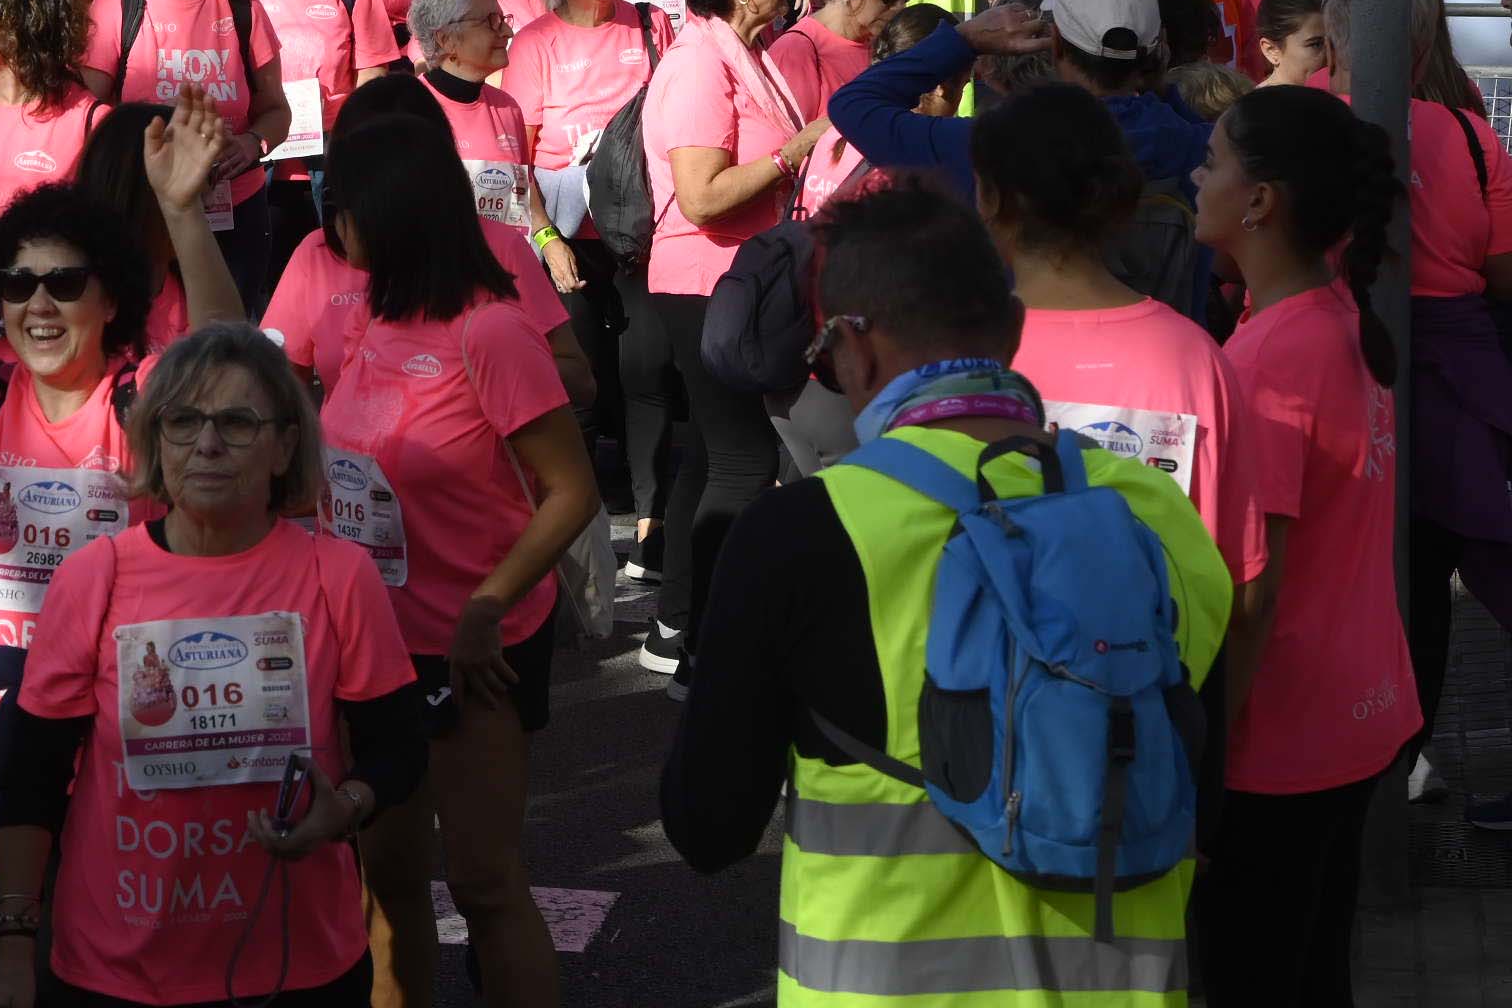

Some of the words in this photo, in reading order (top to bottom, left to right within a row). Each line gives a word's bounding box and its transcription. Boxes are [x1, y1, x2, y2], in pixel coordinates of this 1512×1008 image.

[156, 48, 231, 82] HOY
[478, 196, 504, 210] 016
[1150, 435, 1179, 447] SUMA
[24, 489, 77, 508] ASTURIANA
[334, 498, 365, 521] 016
[23, 523, 71, 548] 016
[26, 551, 64, 567] 26982
[254, 635, 289, 647] SUMA
[175, 647, 243, 663] ASTURIANA
[181, 682, 244, 709] 016
[190, 713, 237, 731] 18171
[144, 738, 195, 751] CARRERA
[196, 737, 210, 748] DE
[213, 736, 226, 747] LA
[231, 733, 266, 745] MUJER
[143, 761, 197, 778] OYSHO
[238, 755, 288, 769] Santand
[116, 869, 244, 914] SUMA
